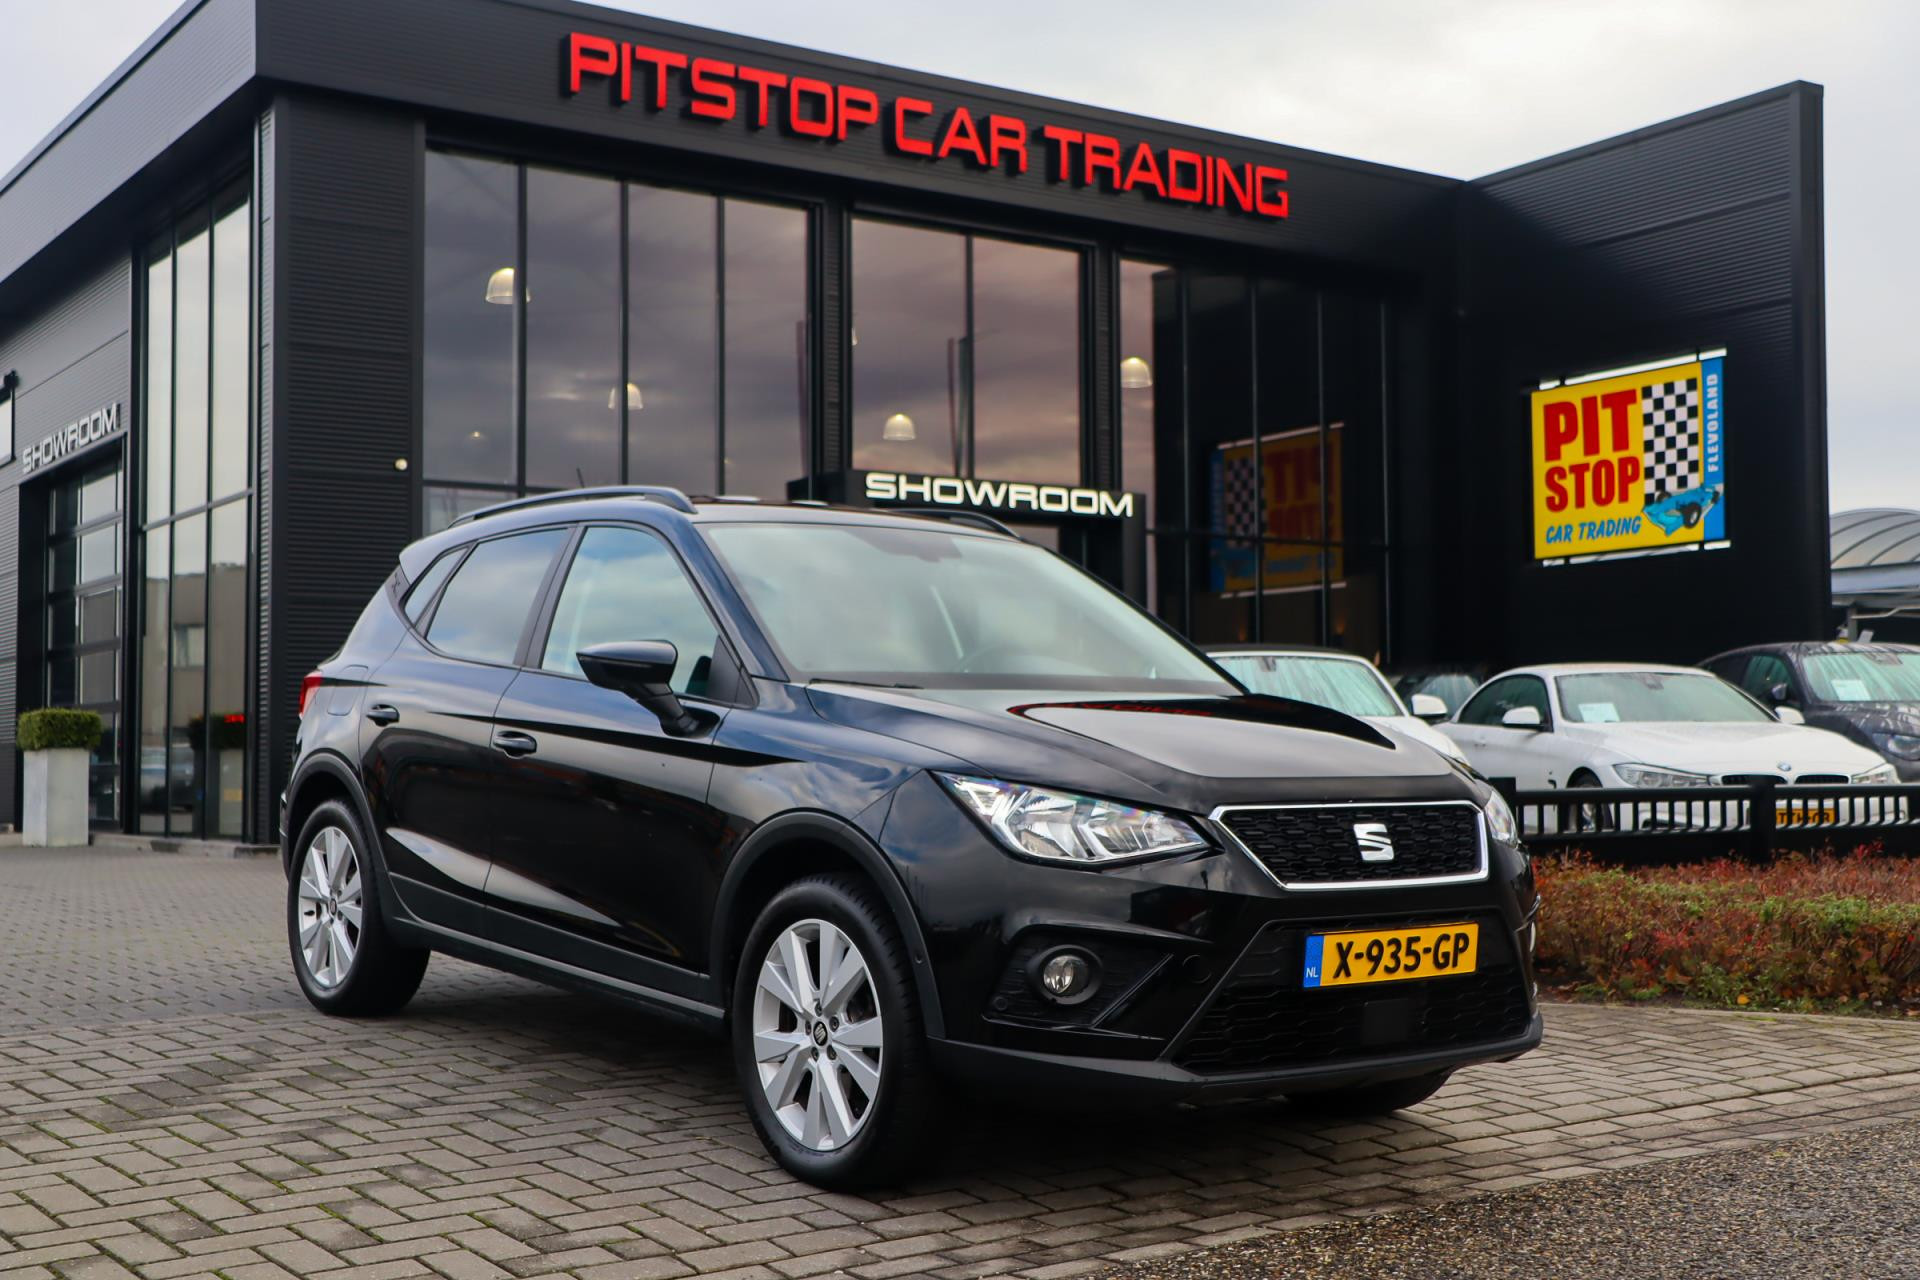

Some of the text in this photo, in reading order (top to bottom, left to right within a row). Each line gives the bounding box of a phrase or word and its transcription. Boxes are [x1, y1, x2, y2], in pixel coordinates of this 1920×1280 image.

[569, 31, 1289, 218] PITSTOP CAR TRADING
[22, 402, 118, 474] SHOWROOM
[1543, 388, 1638, 463] PIT
[1706, 373, 1720, 473] FLEVOLAND
[865, 472, 1134, 518] SHOWROOM
[1544, 455, 1641, 513] STOP
[1545, 515, 1643, 544] CAR TRADING
[1305, 967, 1319, 979] NL
[1333, 932, 1470, 979] X-935-GP
